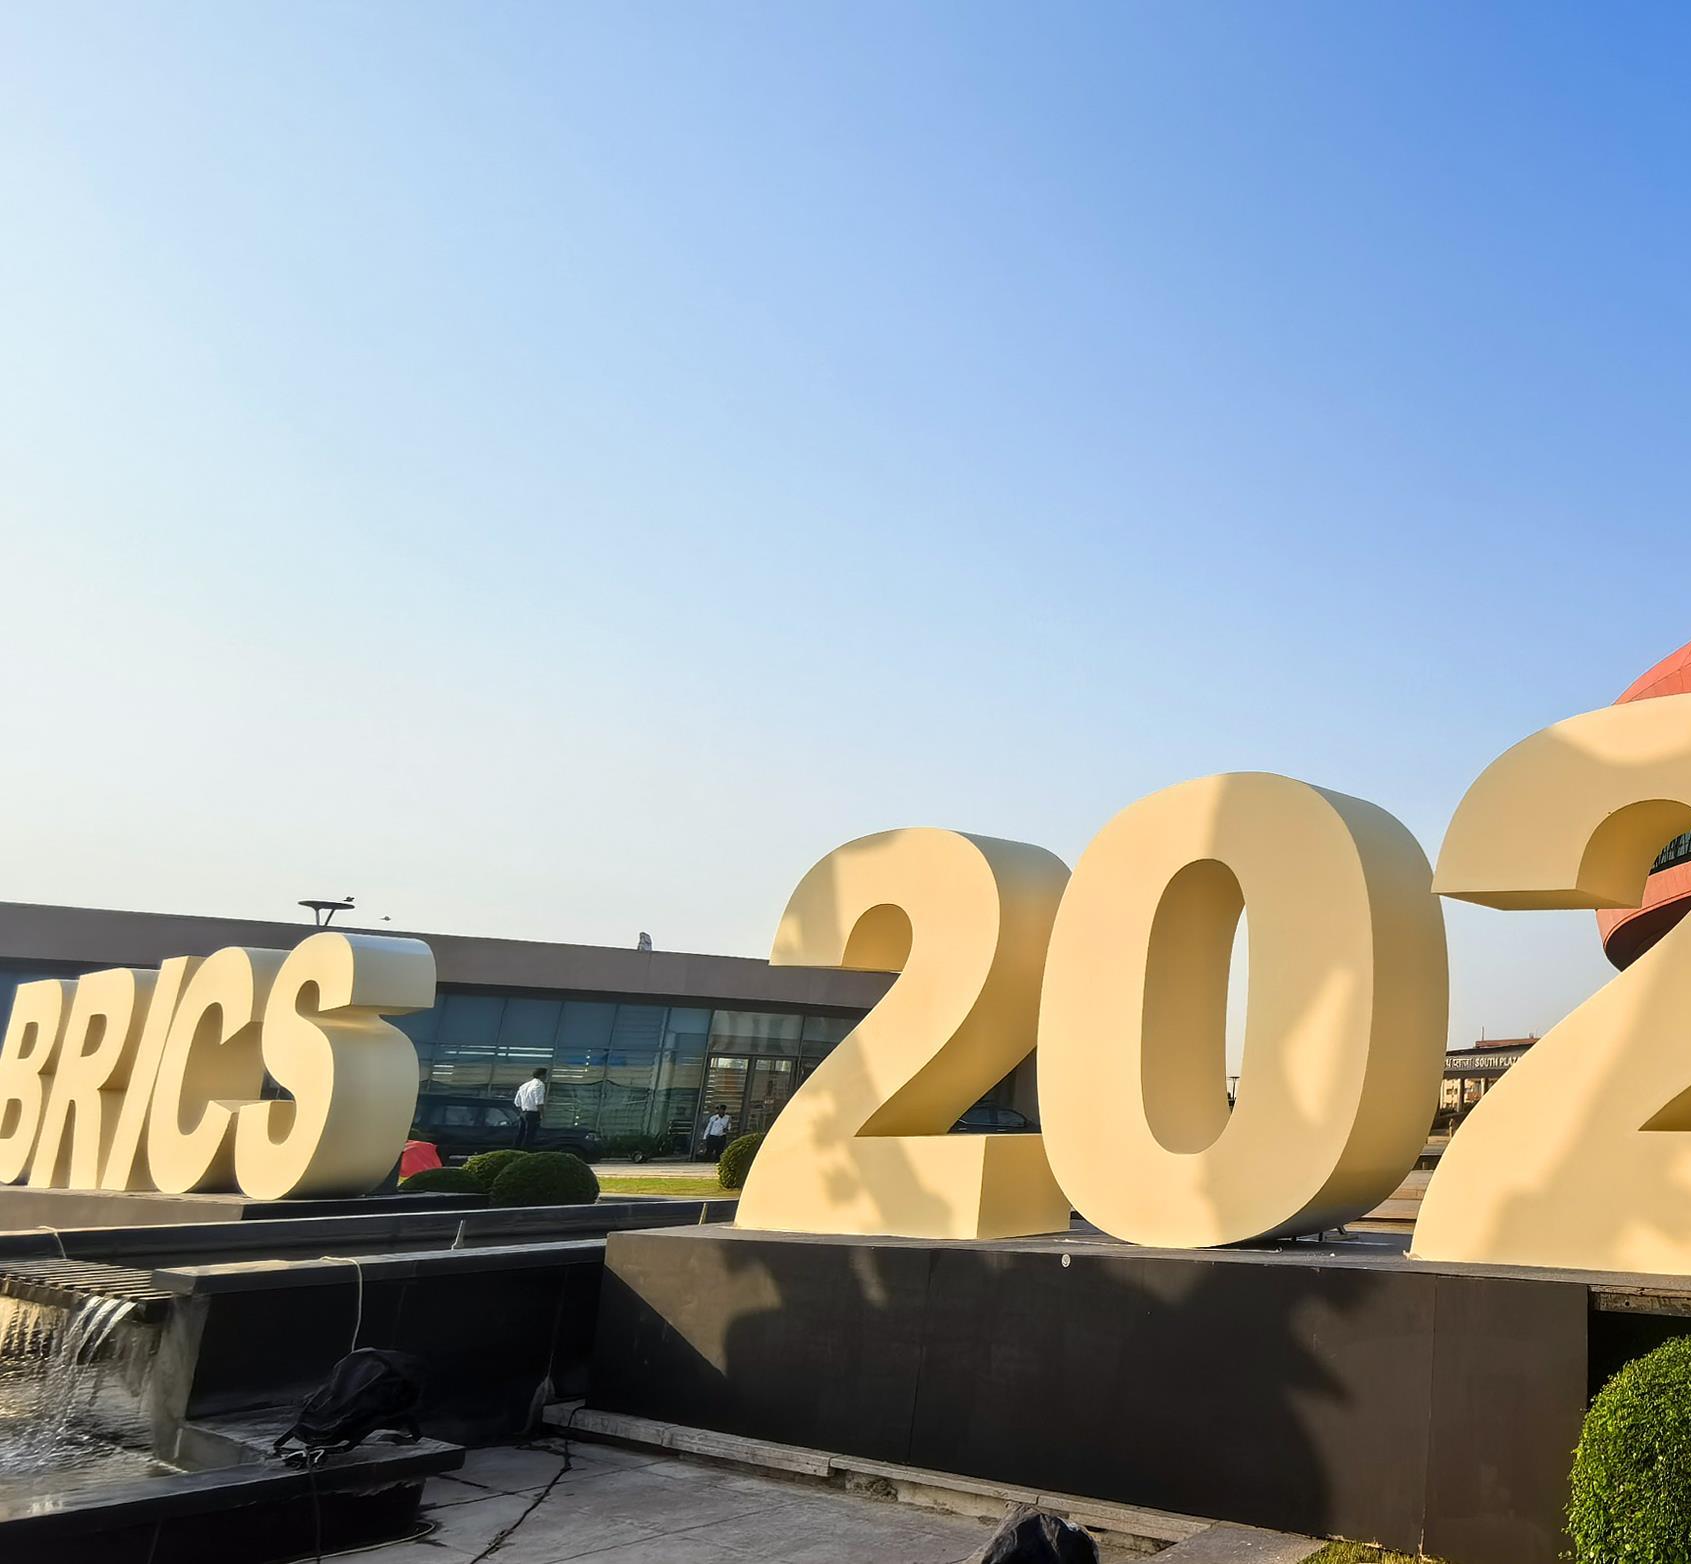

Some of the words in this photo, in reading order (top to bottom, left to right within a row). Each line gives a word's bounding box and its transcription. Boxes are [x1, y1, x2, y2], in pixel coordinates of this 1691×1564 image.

[0, 932, 435, 1201] BRICS
[1475, 1057, 1498, 1068] SOUTH
[1499, 1055, 1521, 1067] PLAZ
